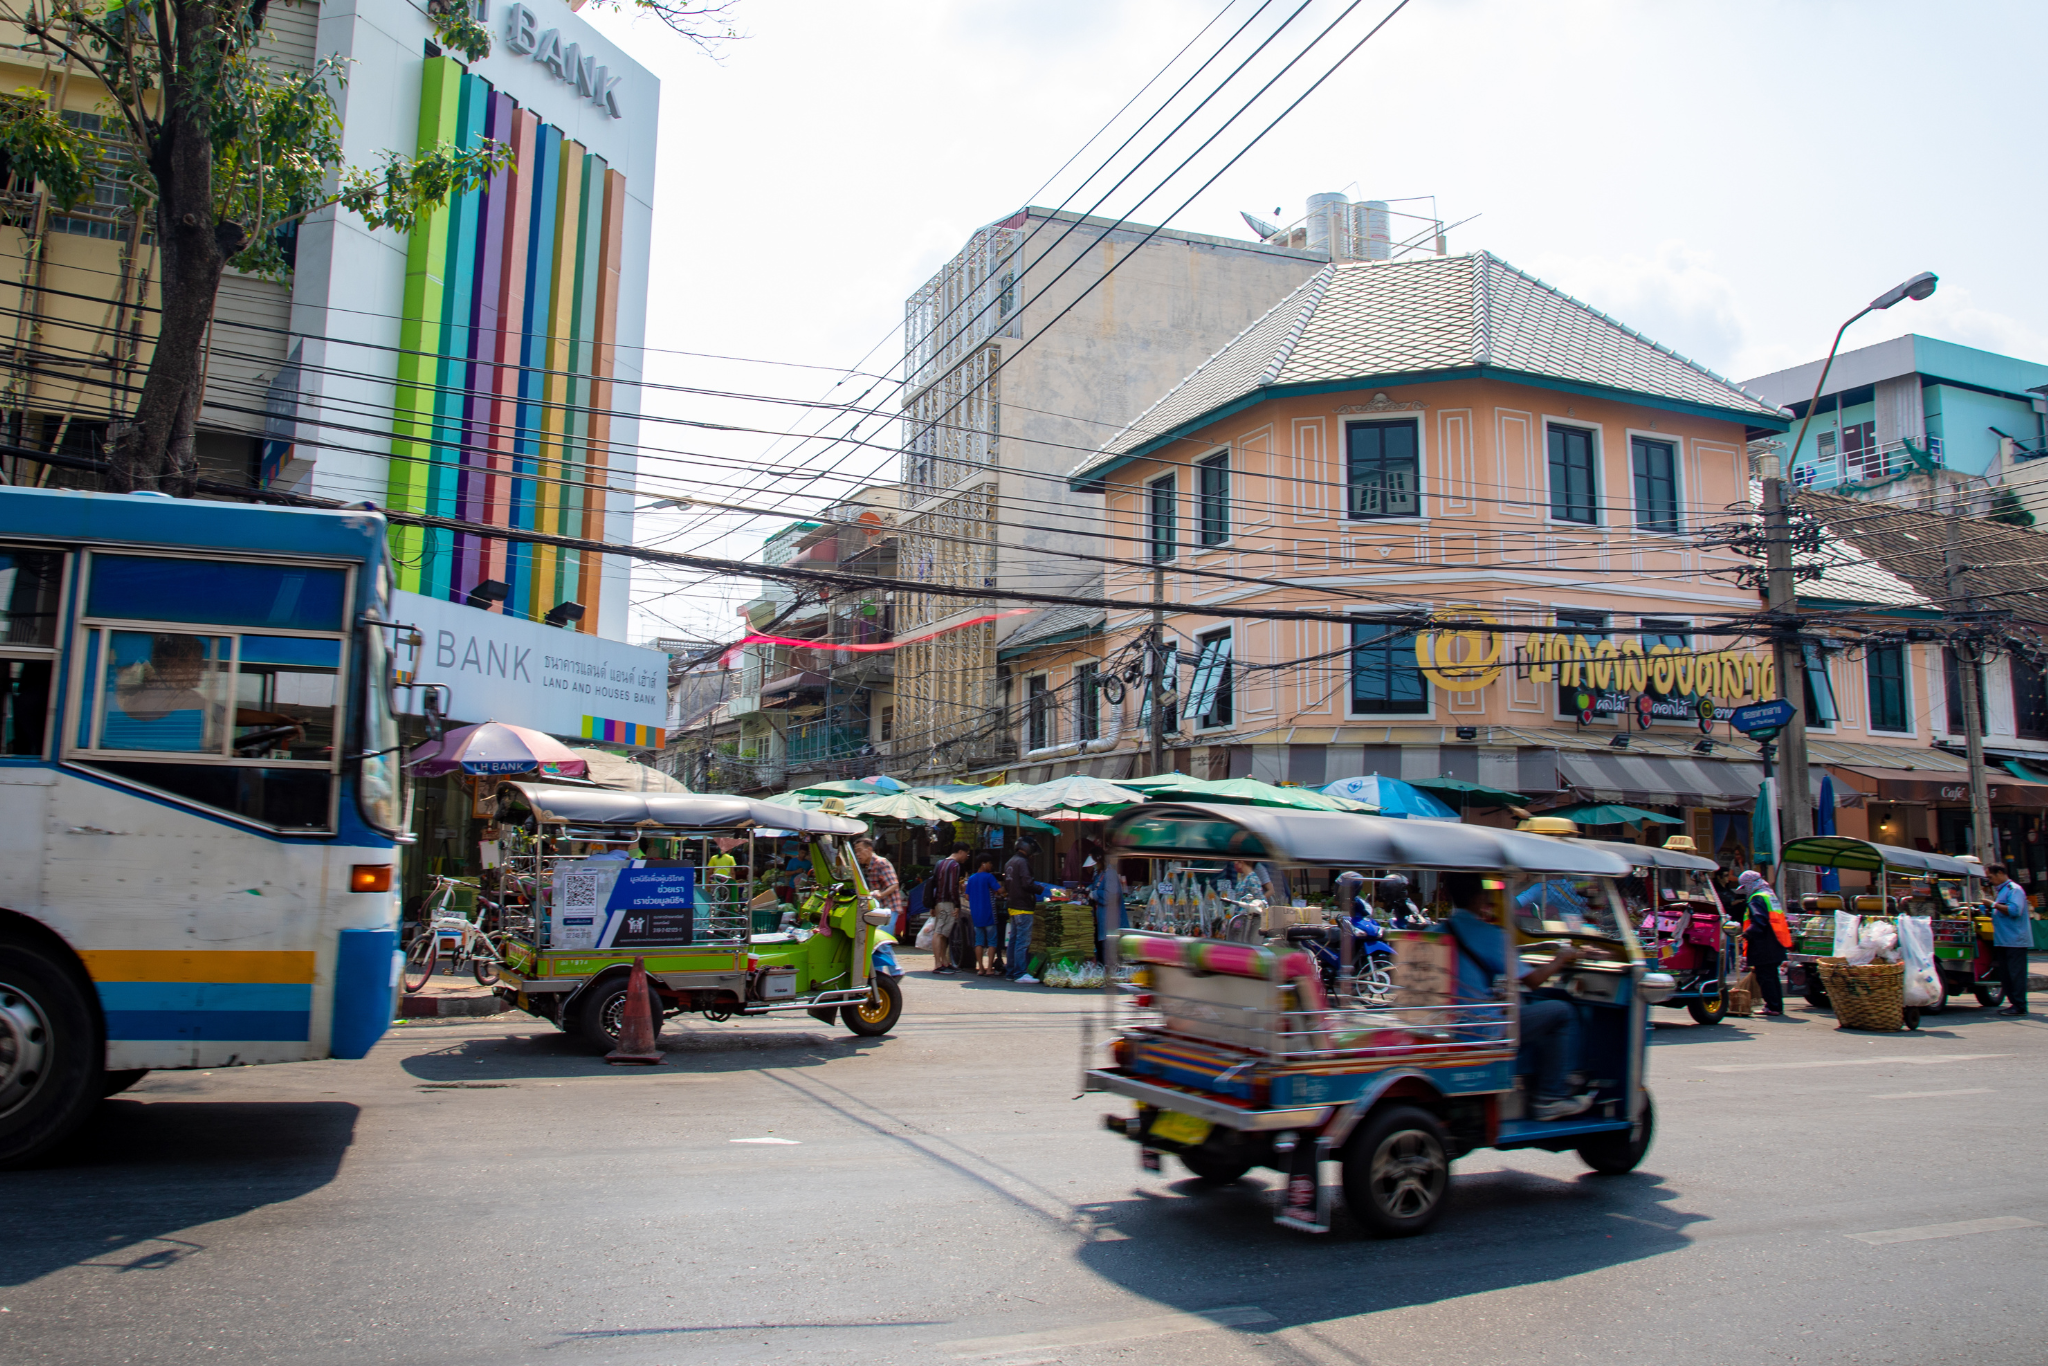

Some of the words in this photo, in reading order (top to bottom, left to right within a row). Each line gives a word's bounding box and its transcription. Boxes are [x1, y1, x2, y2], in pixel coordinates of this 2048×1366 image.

[507, 3, 623, 119] BANK
[436, 629, 532, 684] BANK
[544, 655, 608, 680] ธนาคารแลนด์
[610, 666, 636, 685] แอนด์
[543, 676, 569, 690] LAND
[572, 681, 592, 694] AND
[595, 686, 630, 701] HOUSES
[634, 692, 657, 705] BANK
[1596, 693, 1630, 711] ผลไม้
[1652, 698, 1691, 716] ดอกไม้
[473, 762, 489, 772] LH
[492, 762, 524, 771] BANK
[1940, 786, 1966, 801] Café
